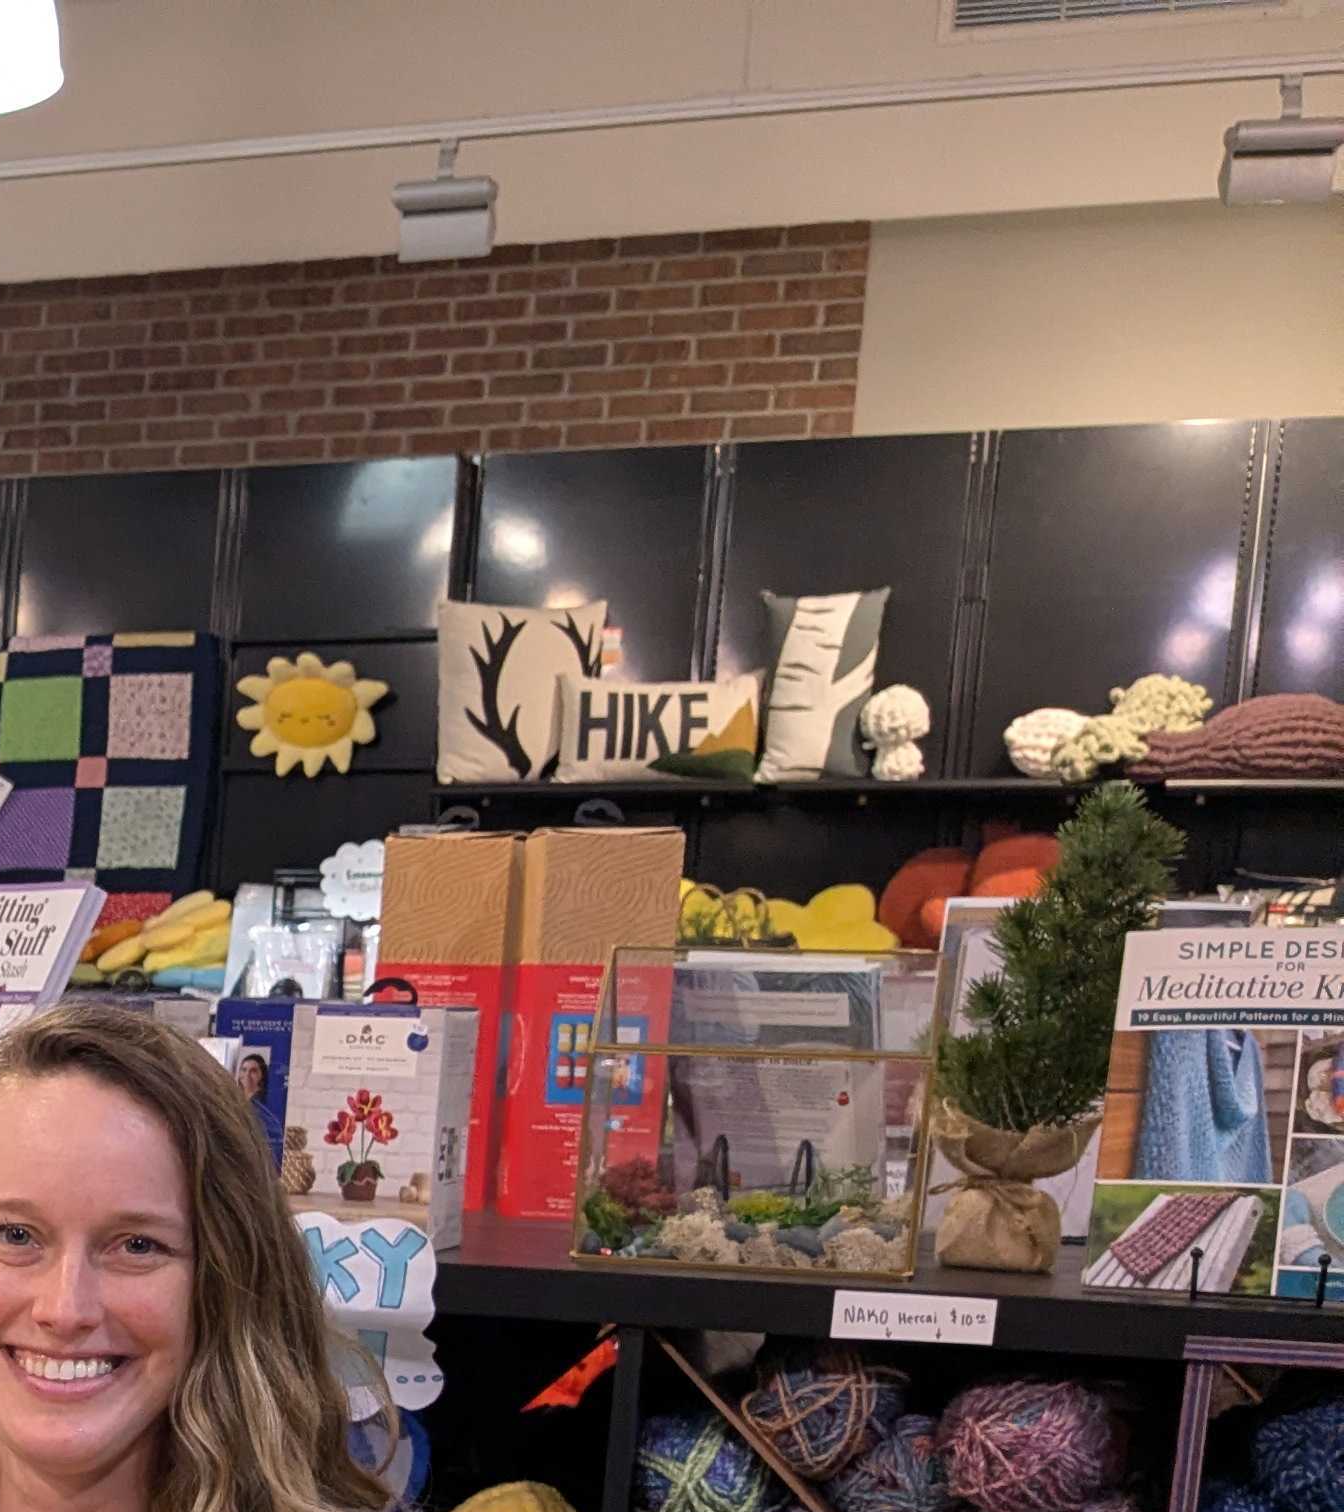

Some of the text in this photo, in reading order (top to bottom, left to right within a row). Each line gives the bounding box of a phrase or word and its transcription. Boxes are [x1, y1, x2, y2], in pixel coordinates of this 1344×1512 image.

[577, 692, 708, 761] HIKE
[0, 926, 56, 956] Stuff
[1178, 941, 1274, 959] SIMPLE
[1276, 961, 1305, 972] FOR
[1137, 973, 1304, 1001] Meditative
[1137, 1013, 1150, 1022] 19
[1153, 1013, 1182, 1024] Easy,
[1185, 1012, 1237, 1022] Beautiful
[1240, 1012, 1288, 1022] Patterns
[1292, 1012, 1309, 1022] for
[1312, 1014, 1320, 1022] a
[346, 1034, 386, 1045] DMC
[843, 1305, 889, 1325] NAKO
[898, 1311, 938, 1325] Hercai
